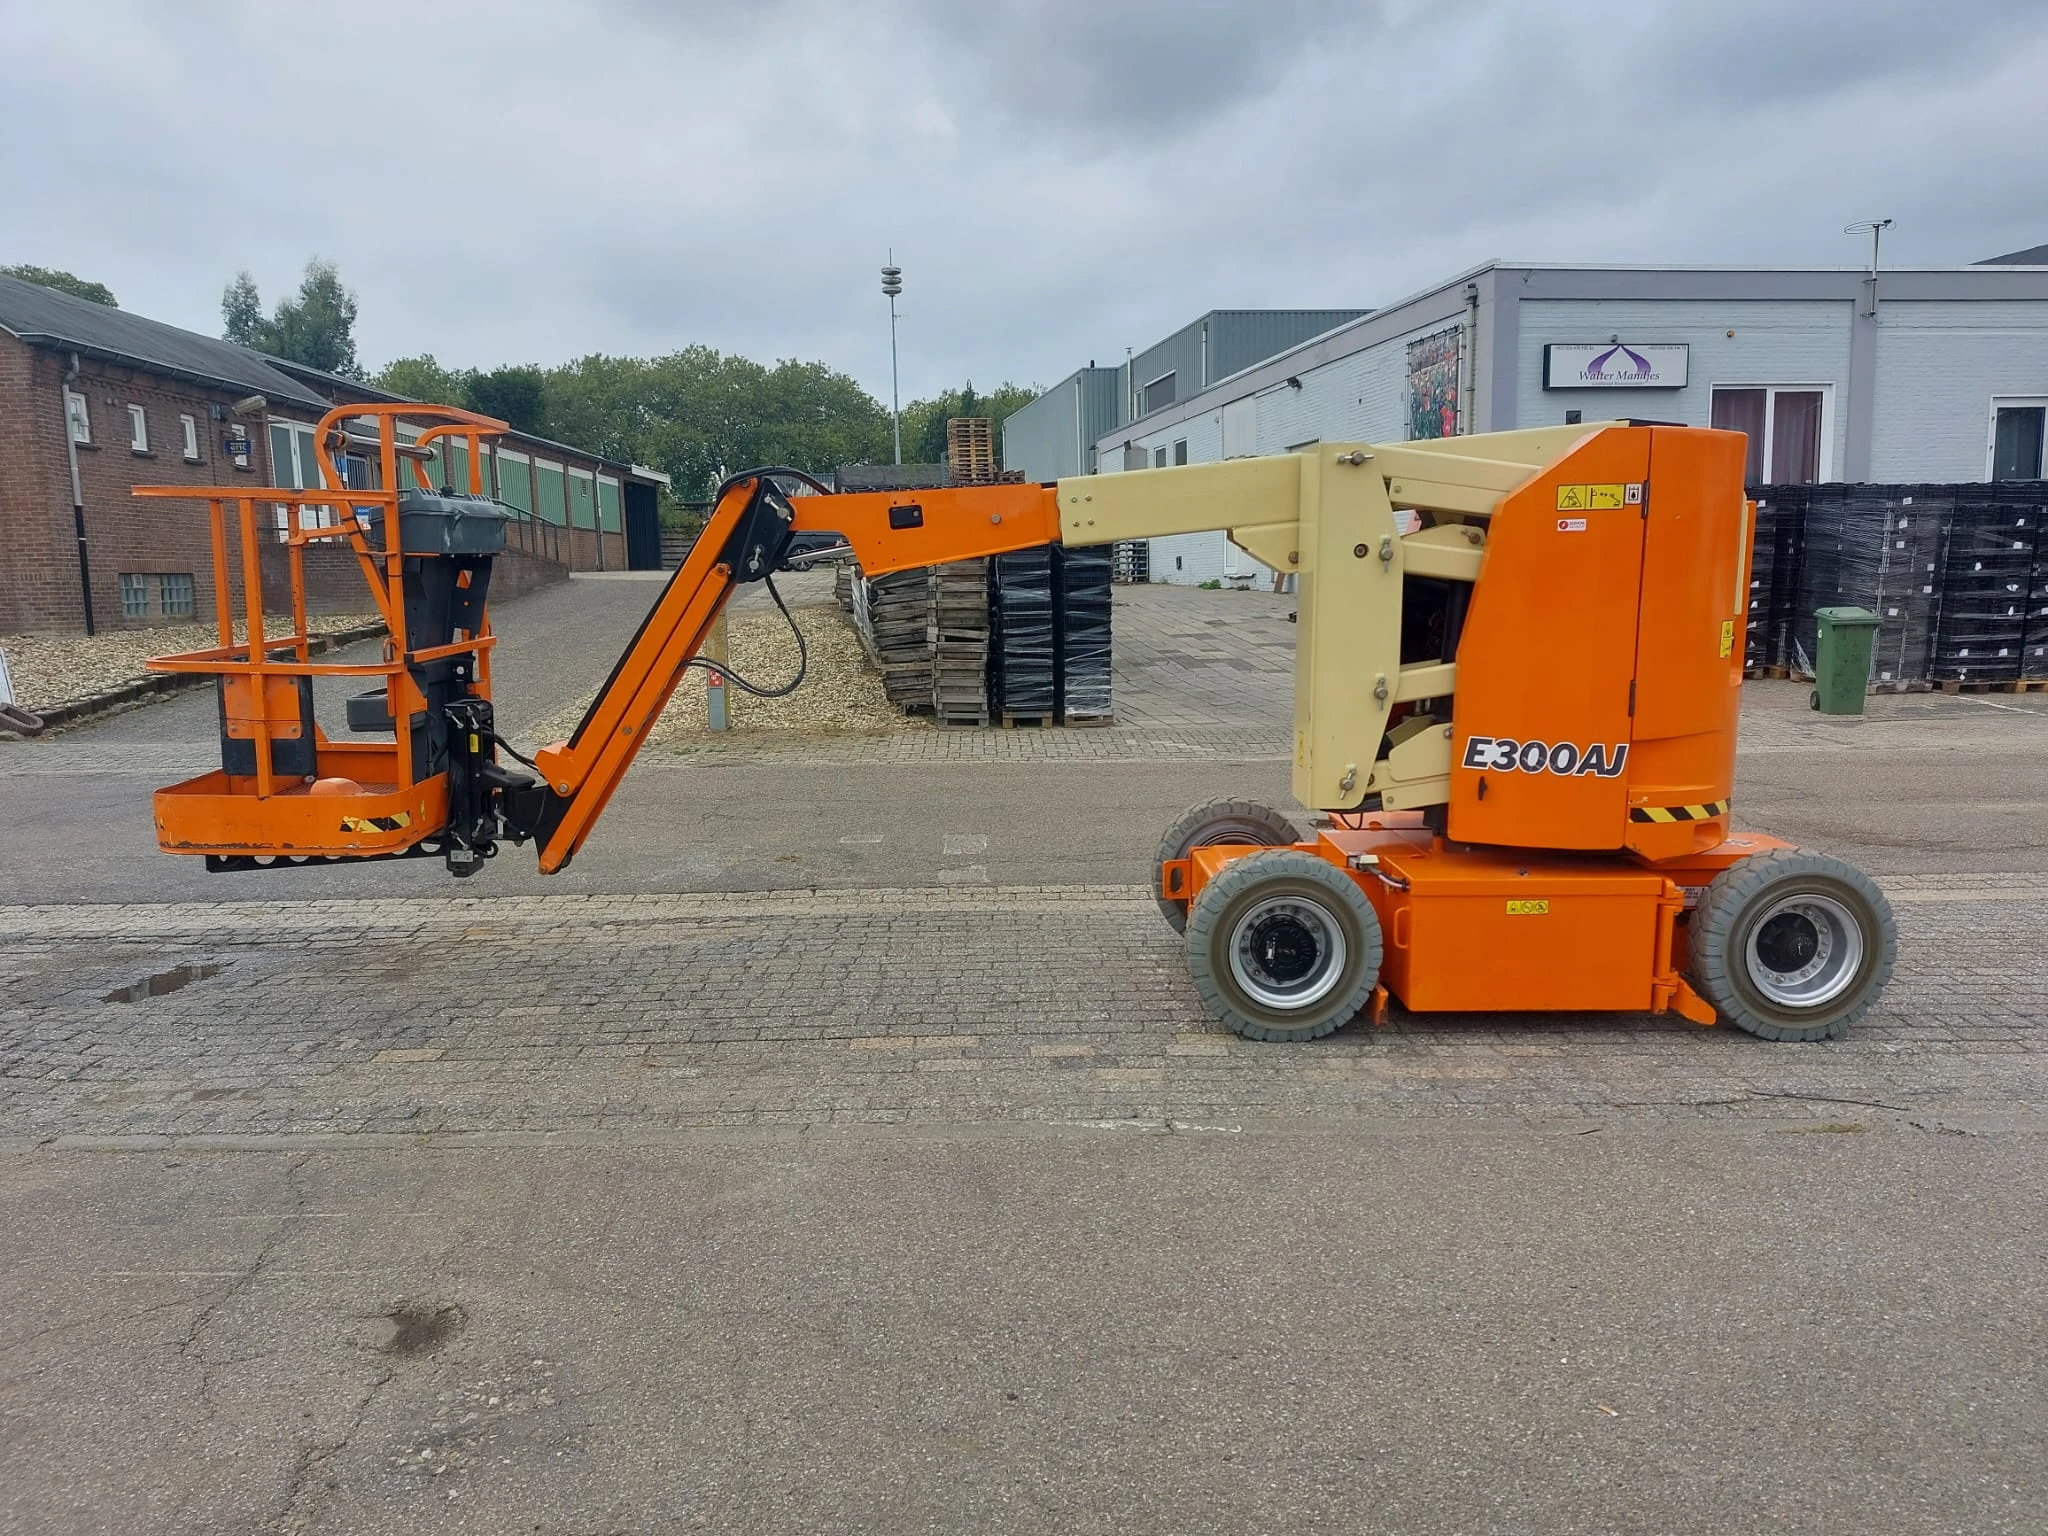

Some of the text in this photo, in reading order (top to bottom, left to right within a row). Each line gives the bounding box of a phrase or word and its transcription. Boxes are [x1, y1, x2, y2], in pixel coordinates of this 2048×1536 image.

[1579, 370, 1660, 383] Walter Mandjes
[1462, 736, 1629, 777] E300AJ
